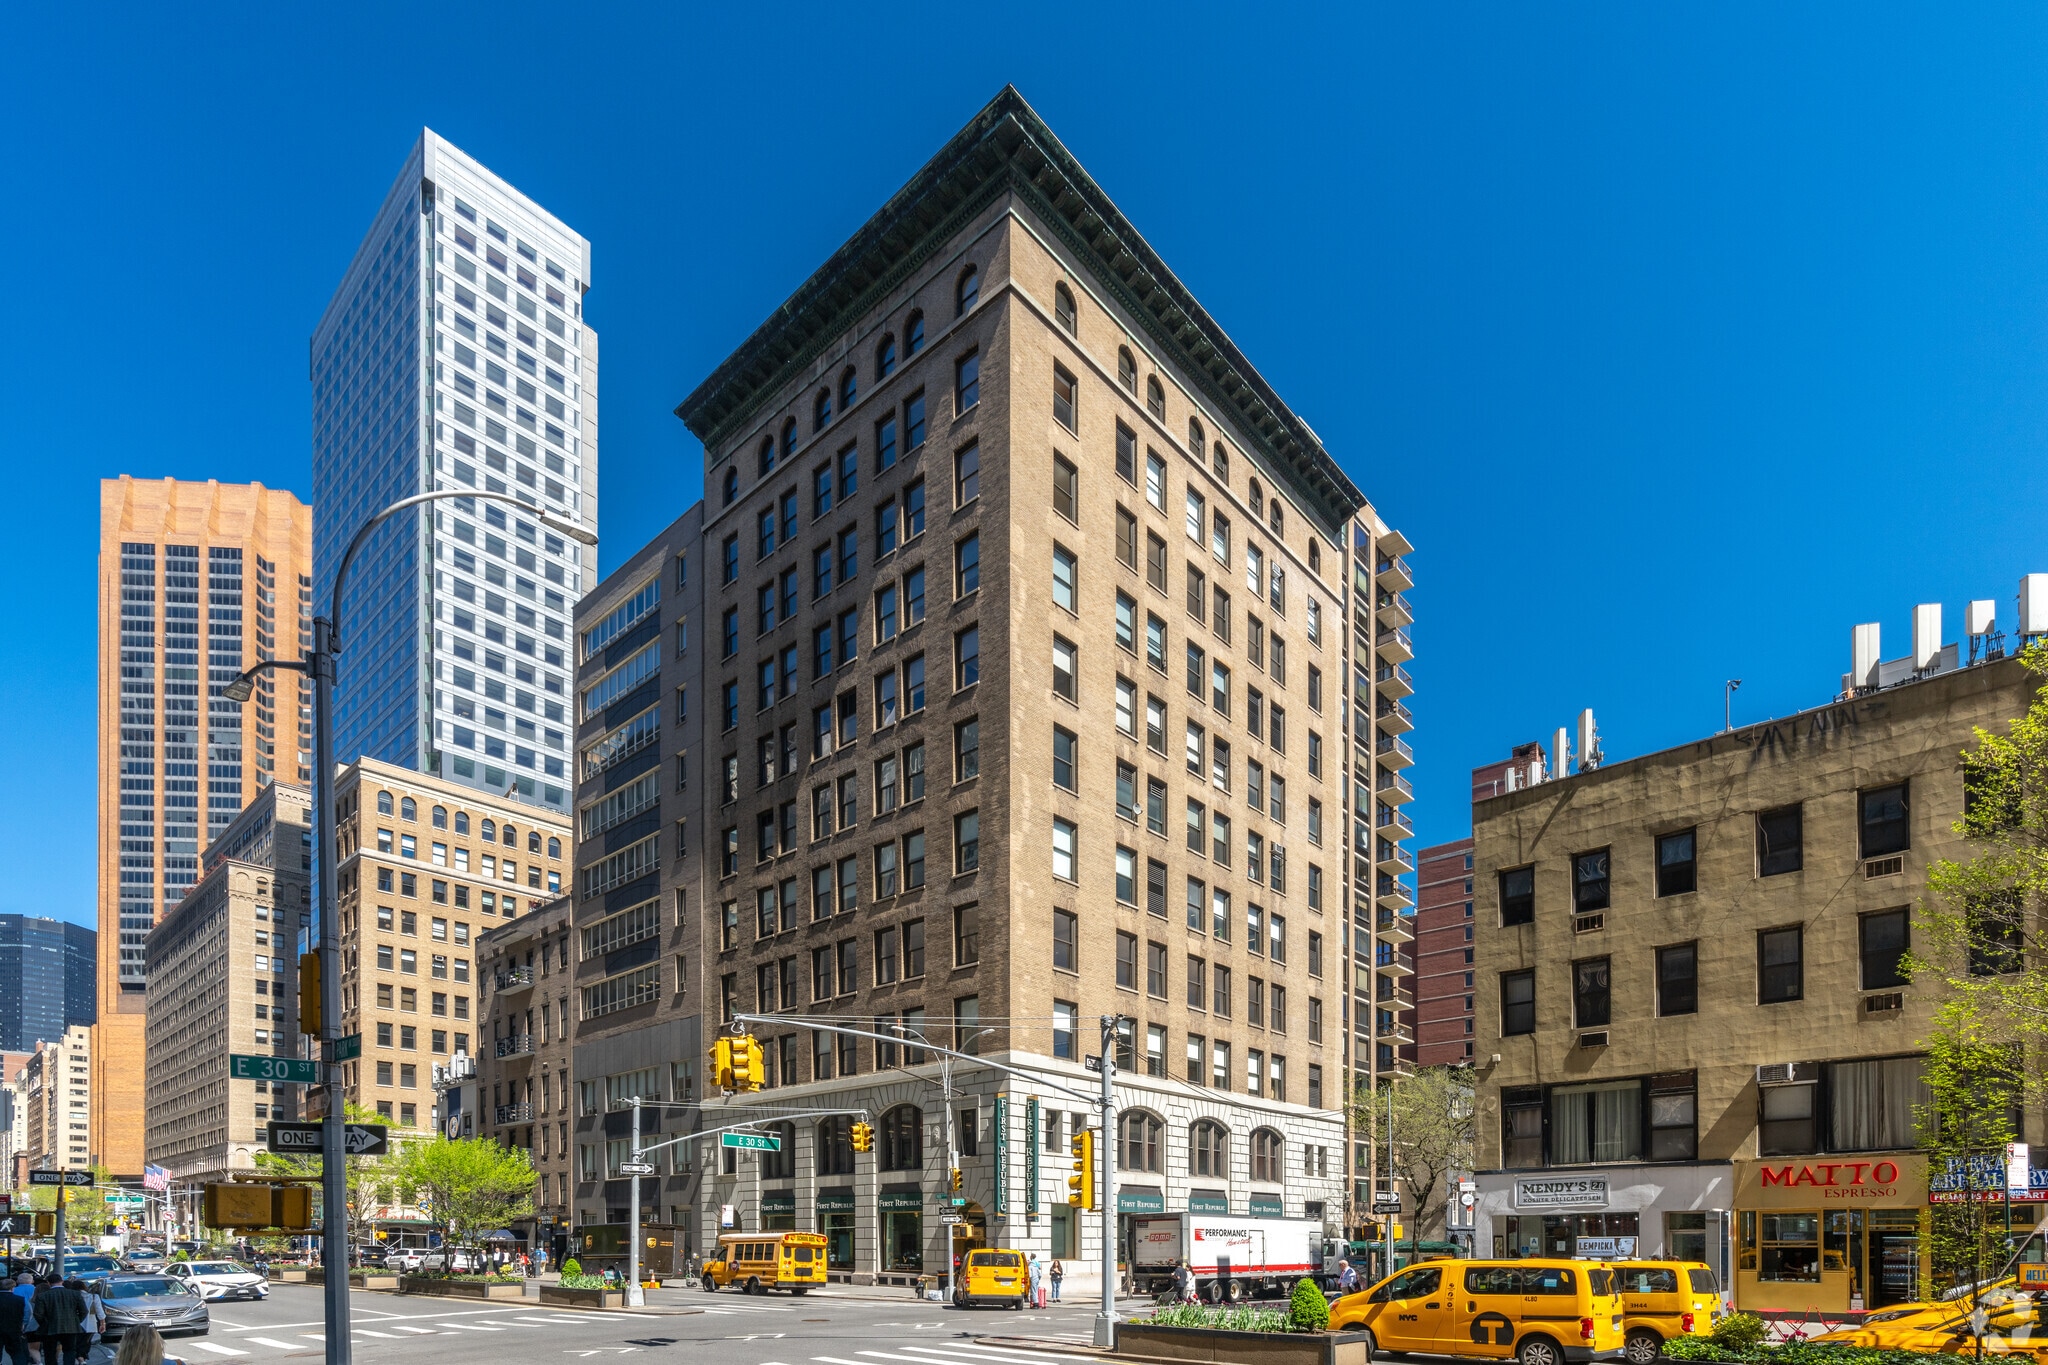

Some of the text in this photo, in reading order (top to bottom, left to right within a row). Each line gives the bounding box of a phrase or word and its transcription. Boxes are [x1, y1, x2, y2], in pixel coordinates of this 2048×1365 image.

[237, 1057, 311, 1079] E 30 ST
[281, 1131, 314, 1144] ONE
[738, 1137, 766, 1148] E 30 St
[1026, 1101, 1034, 1212] FIRST REPUBLIC
[39, 1174, 85, 1183] ONE WAY
[1760, 1160, 1899, 1188] MATTO
[1522, 1181, 1588, 1194] MENDY'S
[1824, 1187, 1897, 1198] ESPRESSO
[1551, 1195, 1602, 1203] DELICATESSEN
[2026, 1190, 2046, 1200] ART
[773, 1203, 796, 1211] REPUBLIC
[816, 1201, 855, 1209] FIRST REPUBLIC
[878, 1198, 923, 1207] FIRST REPUBLIC
[1121, 1200, 1161, 1209] FIRST REPUBLIC
[1204, 1203, 1226, 1211] REPUBLIC
[1205, 1228, 1247, 1238] PERFORMANCE
[1578, 1241, 1613, 1251] LEMPICKA
